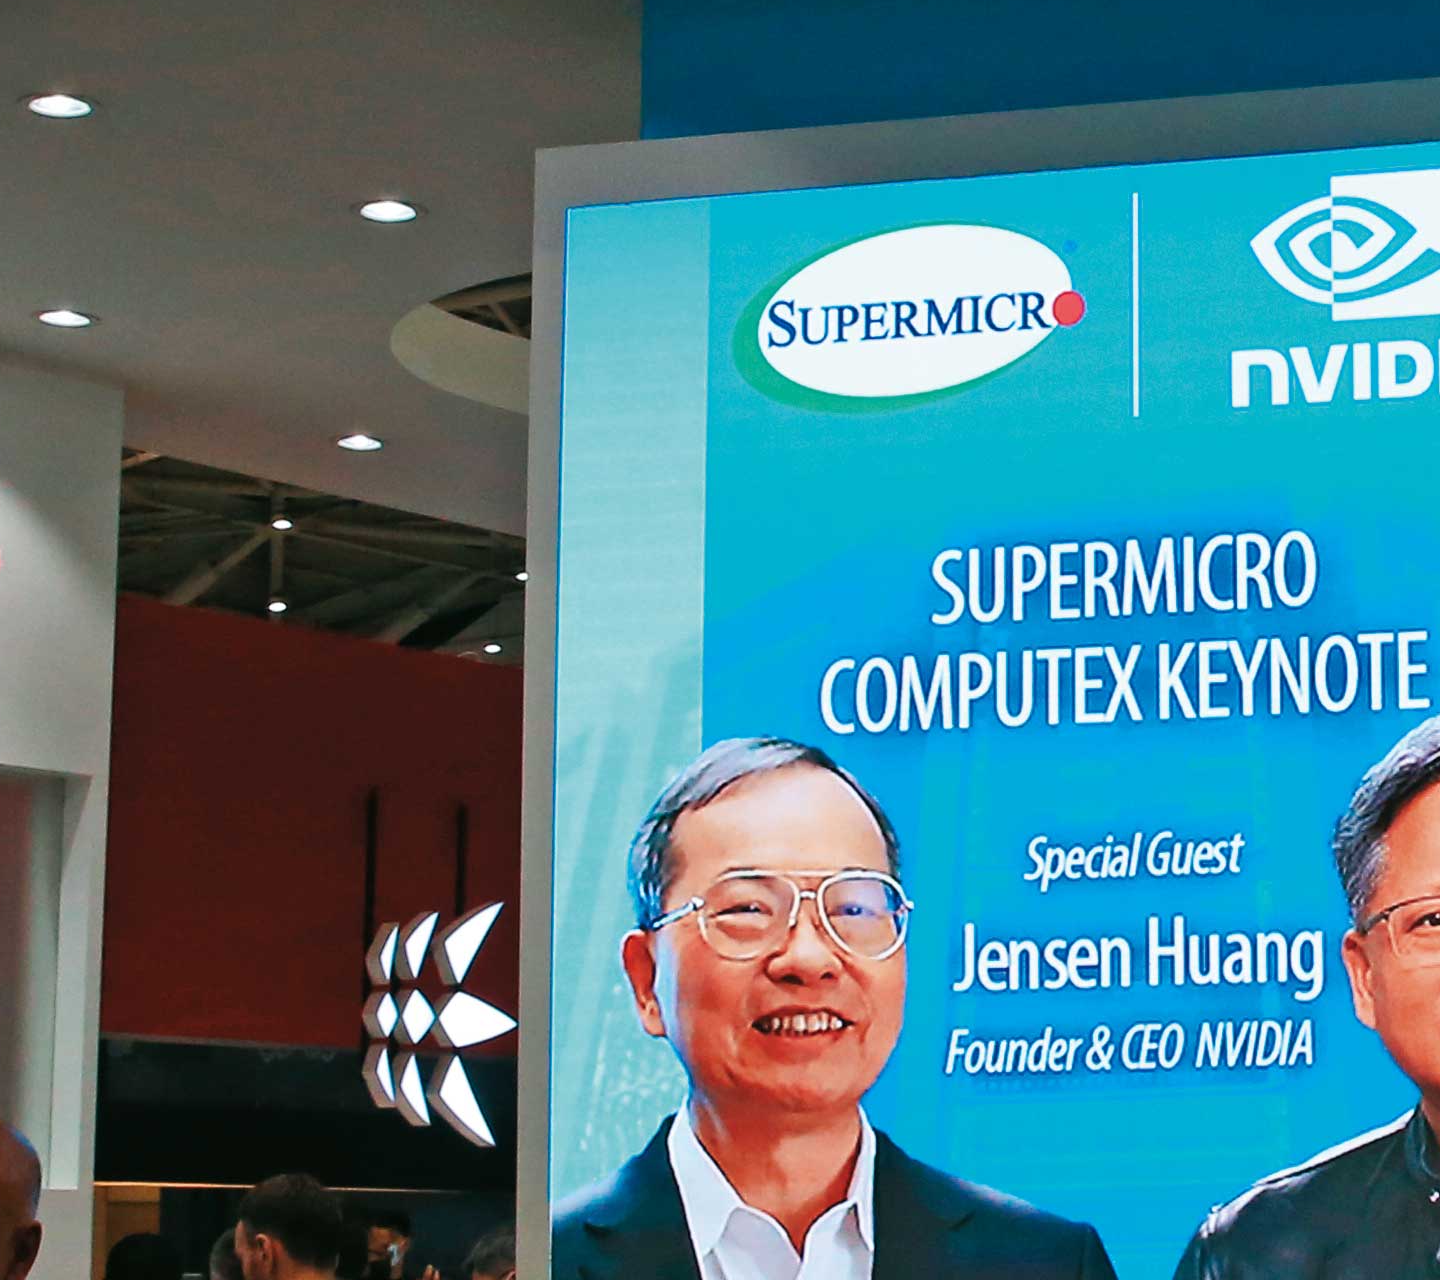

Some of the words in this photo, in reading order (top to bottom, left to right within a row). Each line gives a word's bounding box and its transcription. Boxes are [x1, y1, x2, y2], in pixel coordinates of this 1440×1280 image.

[930, 530, 1316, 626] SUPERMICRO
[820, 645, 1142, 734] COMPUTEX
[1157, 630, 1429, 720] KEYNOTE
[1025, 835, 1141, 889] Special
[1147, 833, 1243, 880] Guest
[954, 921, 1134, 994] Jensen
[1147, 917, 1325, 1001] Huang
[946, 1024, 1081, 1075] Founder
[1085, 1027, 1112, 1067] &
[1121, 1025, 1185, 1069] CEO
[1195, 1019, 1313, 1068] NVIDIA
